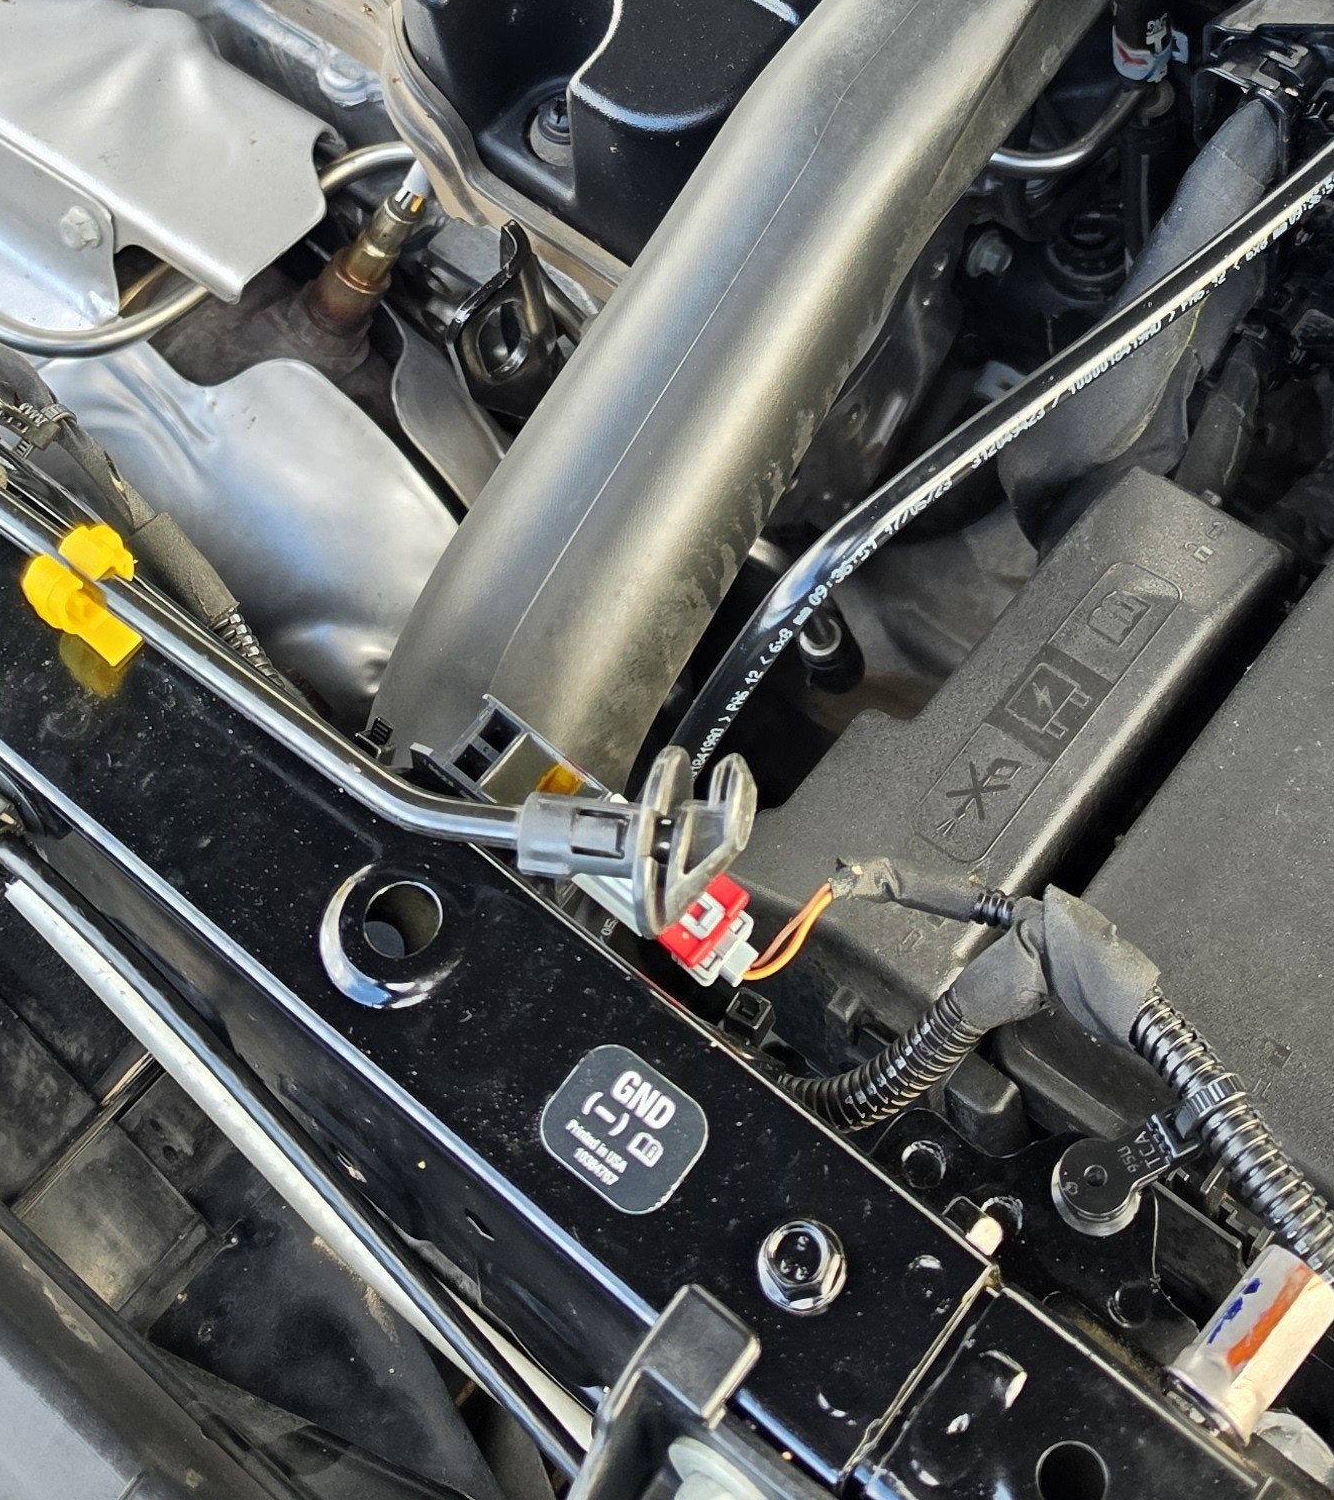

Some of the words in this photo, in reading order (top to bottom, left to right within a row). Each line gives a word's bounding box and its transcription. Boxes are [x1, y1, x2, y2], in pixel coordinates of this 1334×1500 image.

[612, 1070, 676, 1129] GND
[565, 1119, 601, 1150] Printed
[605, 1150, 628, 1174] USA
